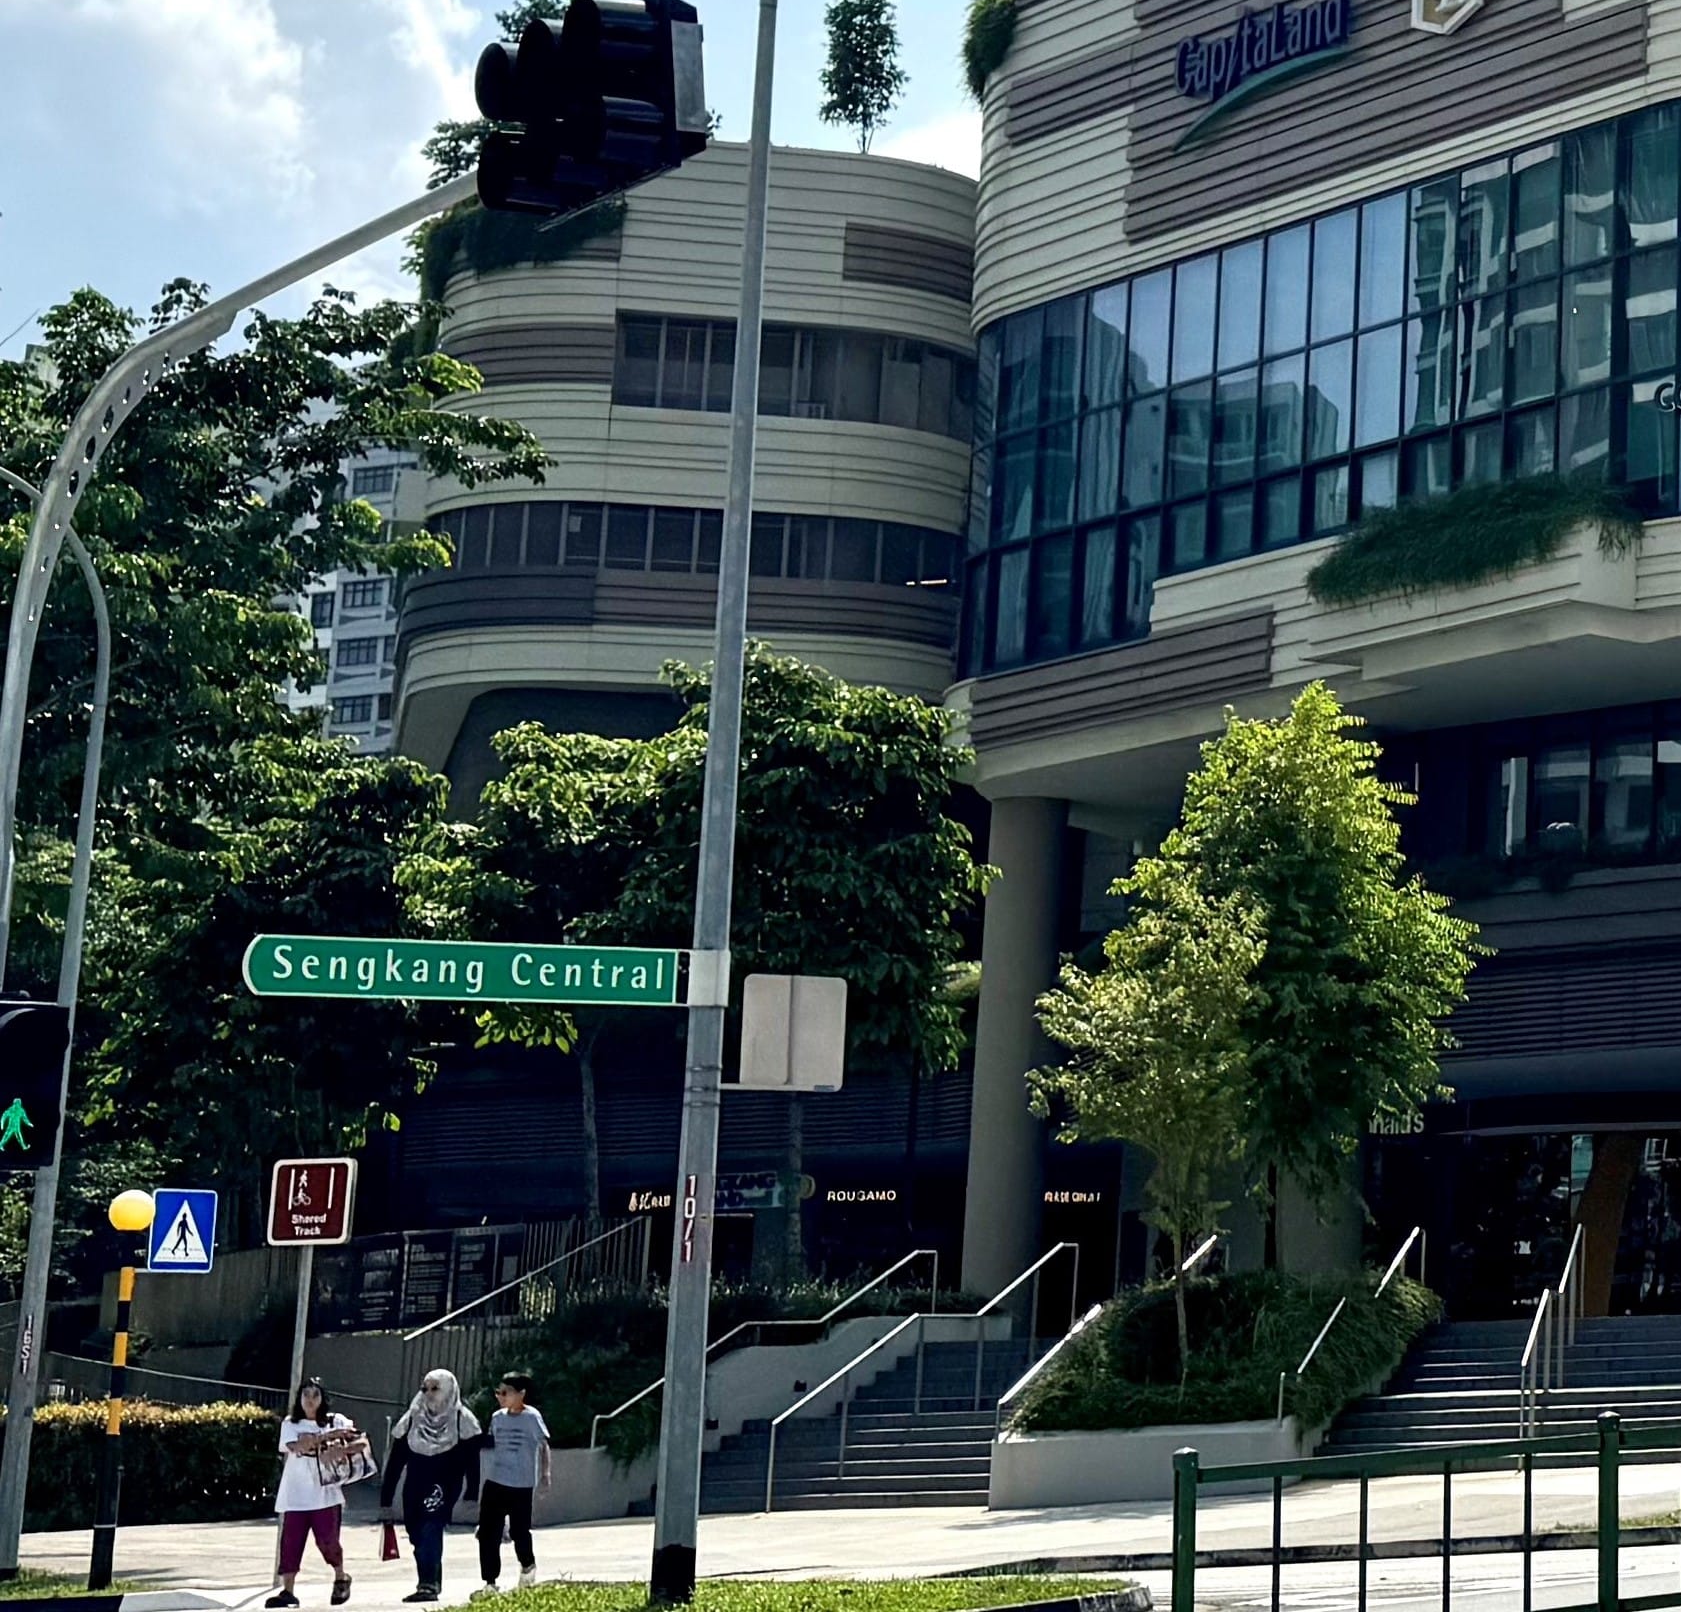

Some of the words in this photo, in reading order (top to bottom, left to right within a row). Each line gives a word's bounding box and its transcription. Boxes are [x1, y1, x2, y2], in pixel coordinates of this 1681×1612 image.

[272, 944, 485, 993] Sengkang
[510, 952, 664, 990] Central
[827, 1190, 897, 1202] ROUGAMO
[291, 1212, 327, 1225] Shared
[683, 1174, 697, 1263] 10/1
